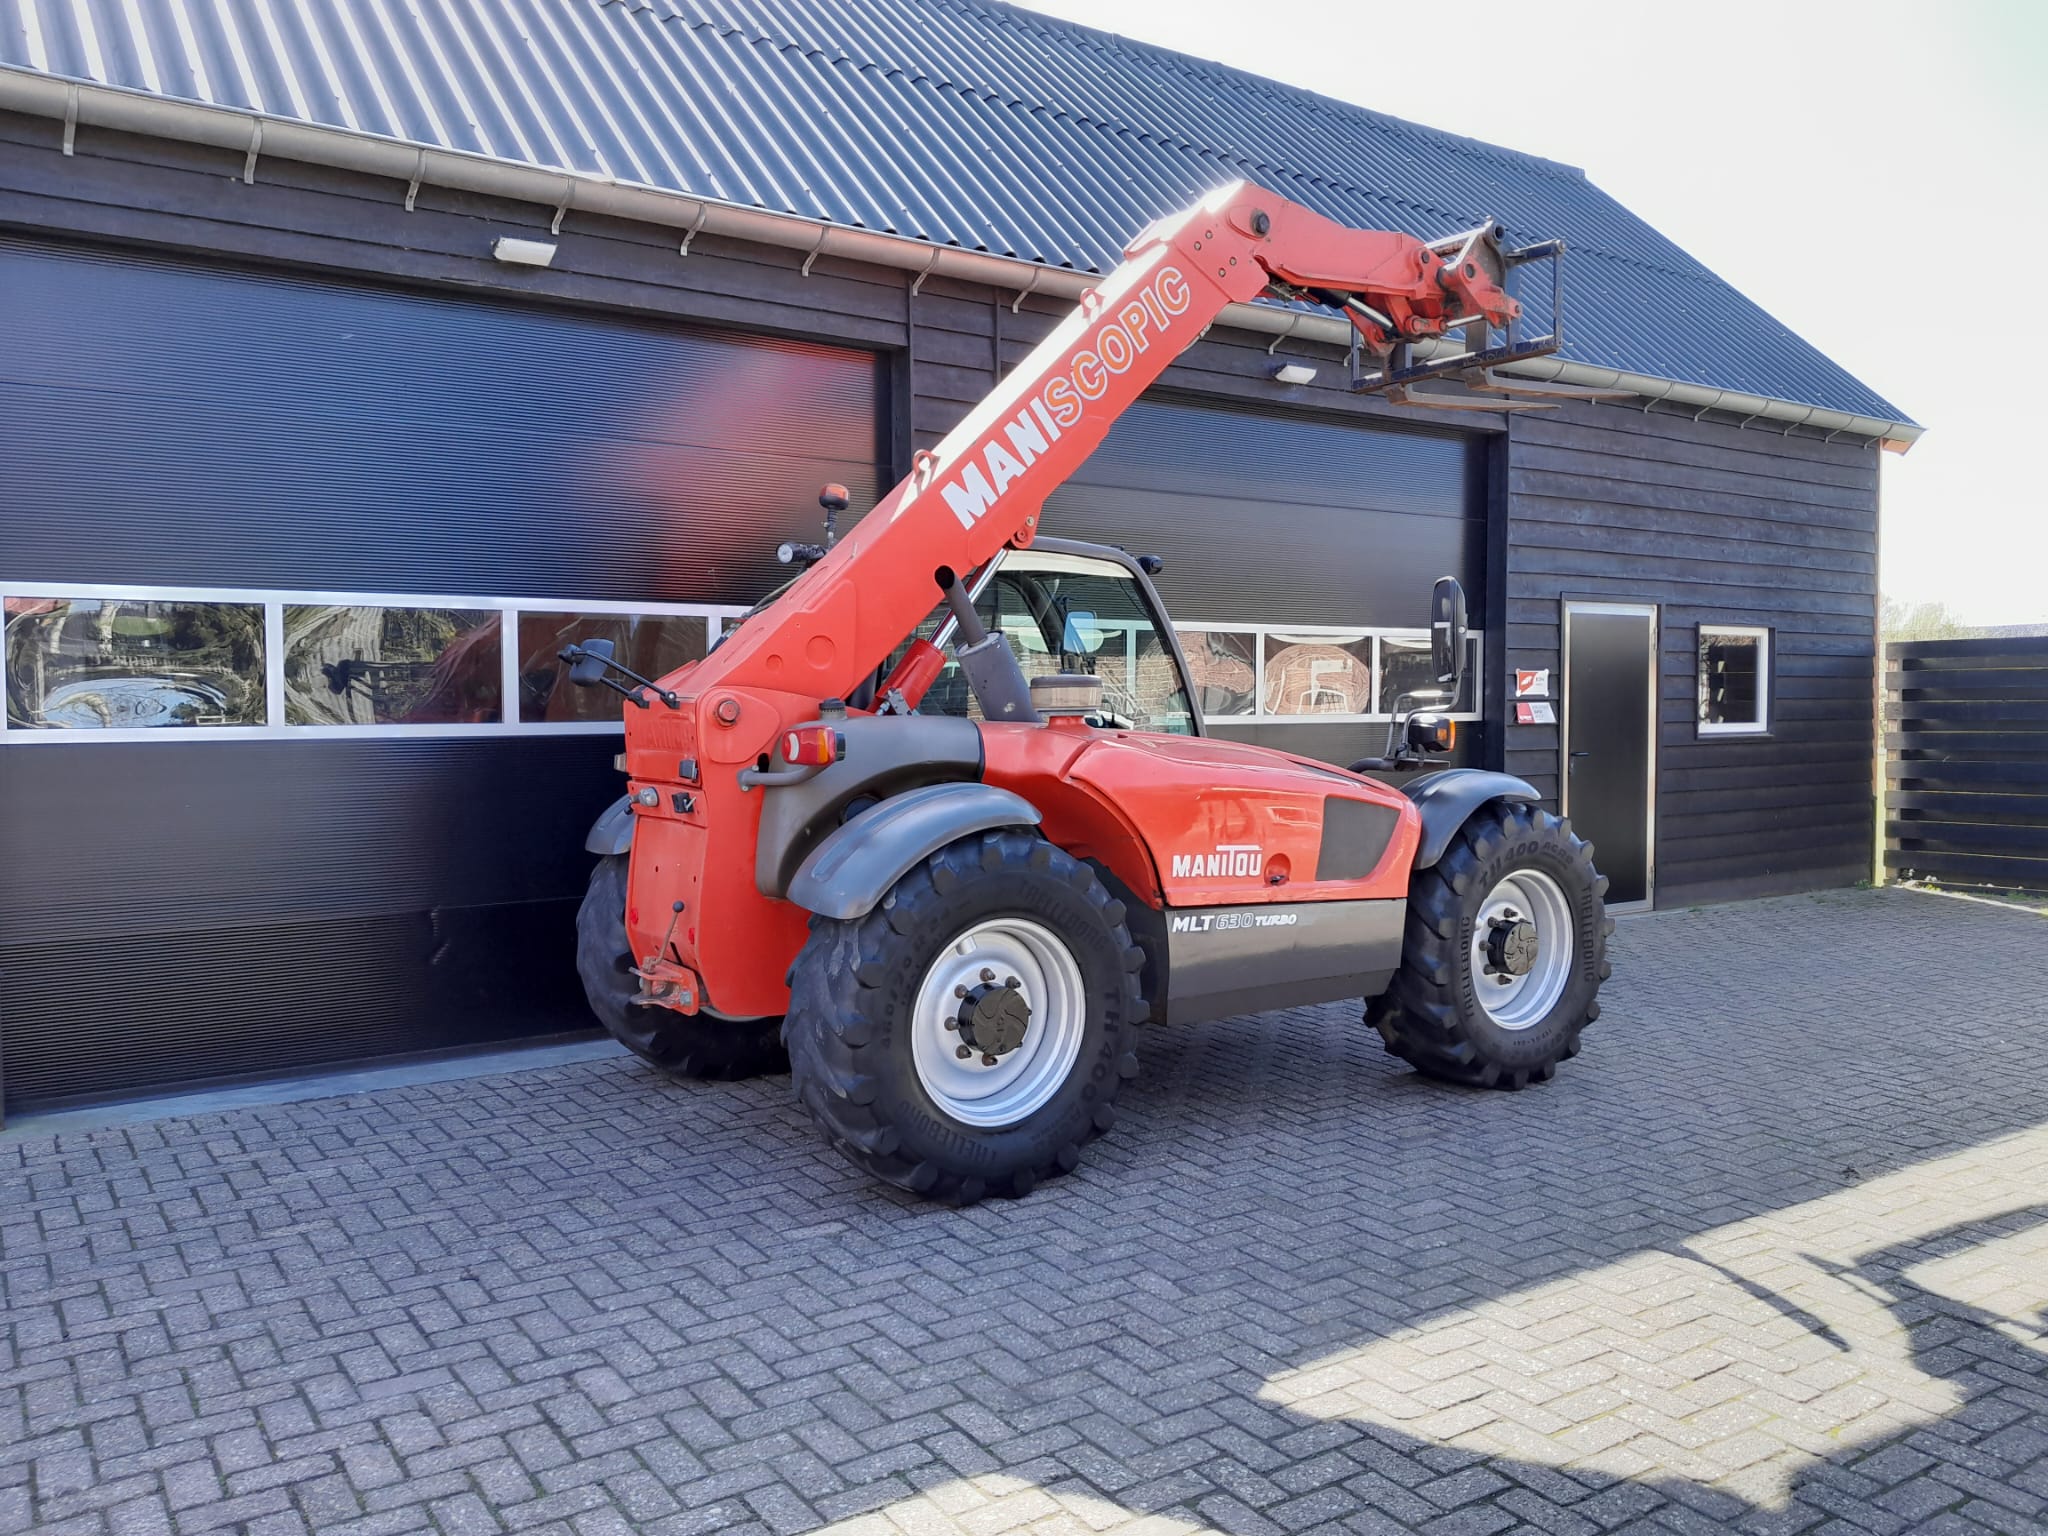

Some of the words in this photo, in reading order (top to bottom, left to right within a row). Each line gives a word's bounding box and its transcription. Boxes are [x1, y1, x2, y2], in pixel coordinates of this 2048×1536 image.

[939, 265, 1190, 530] MANISCOPIC
[1172, 844, 1263, 878] MANITOU
[1506, 840, 1540, 861] 400
[1172, 914, 1215, 933] MLT
[1216, 912, 1254, 930] 630
[1255, 913, 1297, 927] TURBO
[1581, 884, 1597, 983] TRELLEBORG
[1460, 916, 1475, 1018] TRELLEBORG
[1103, 985, 1121, 1033] TH
[1080, 1041, 1113, 1101] 400
